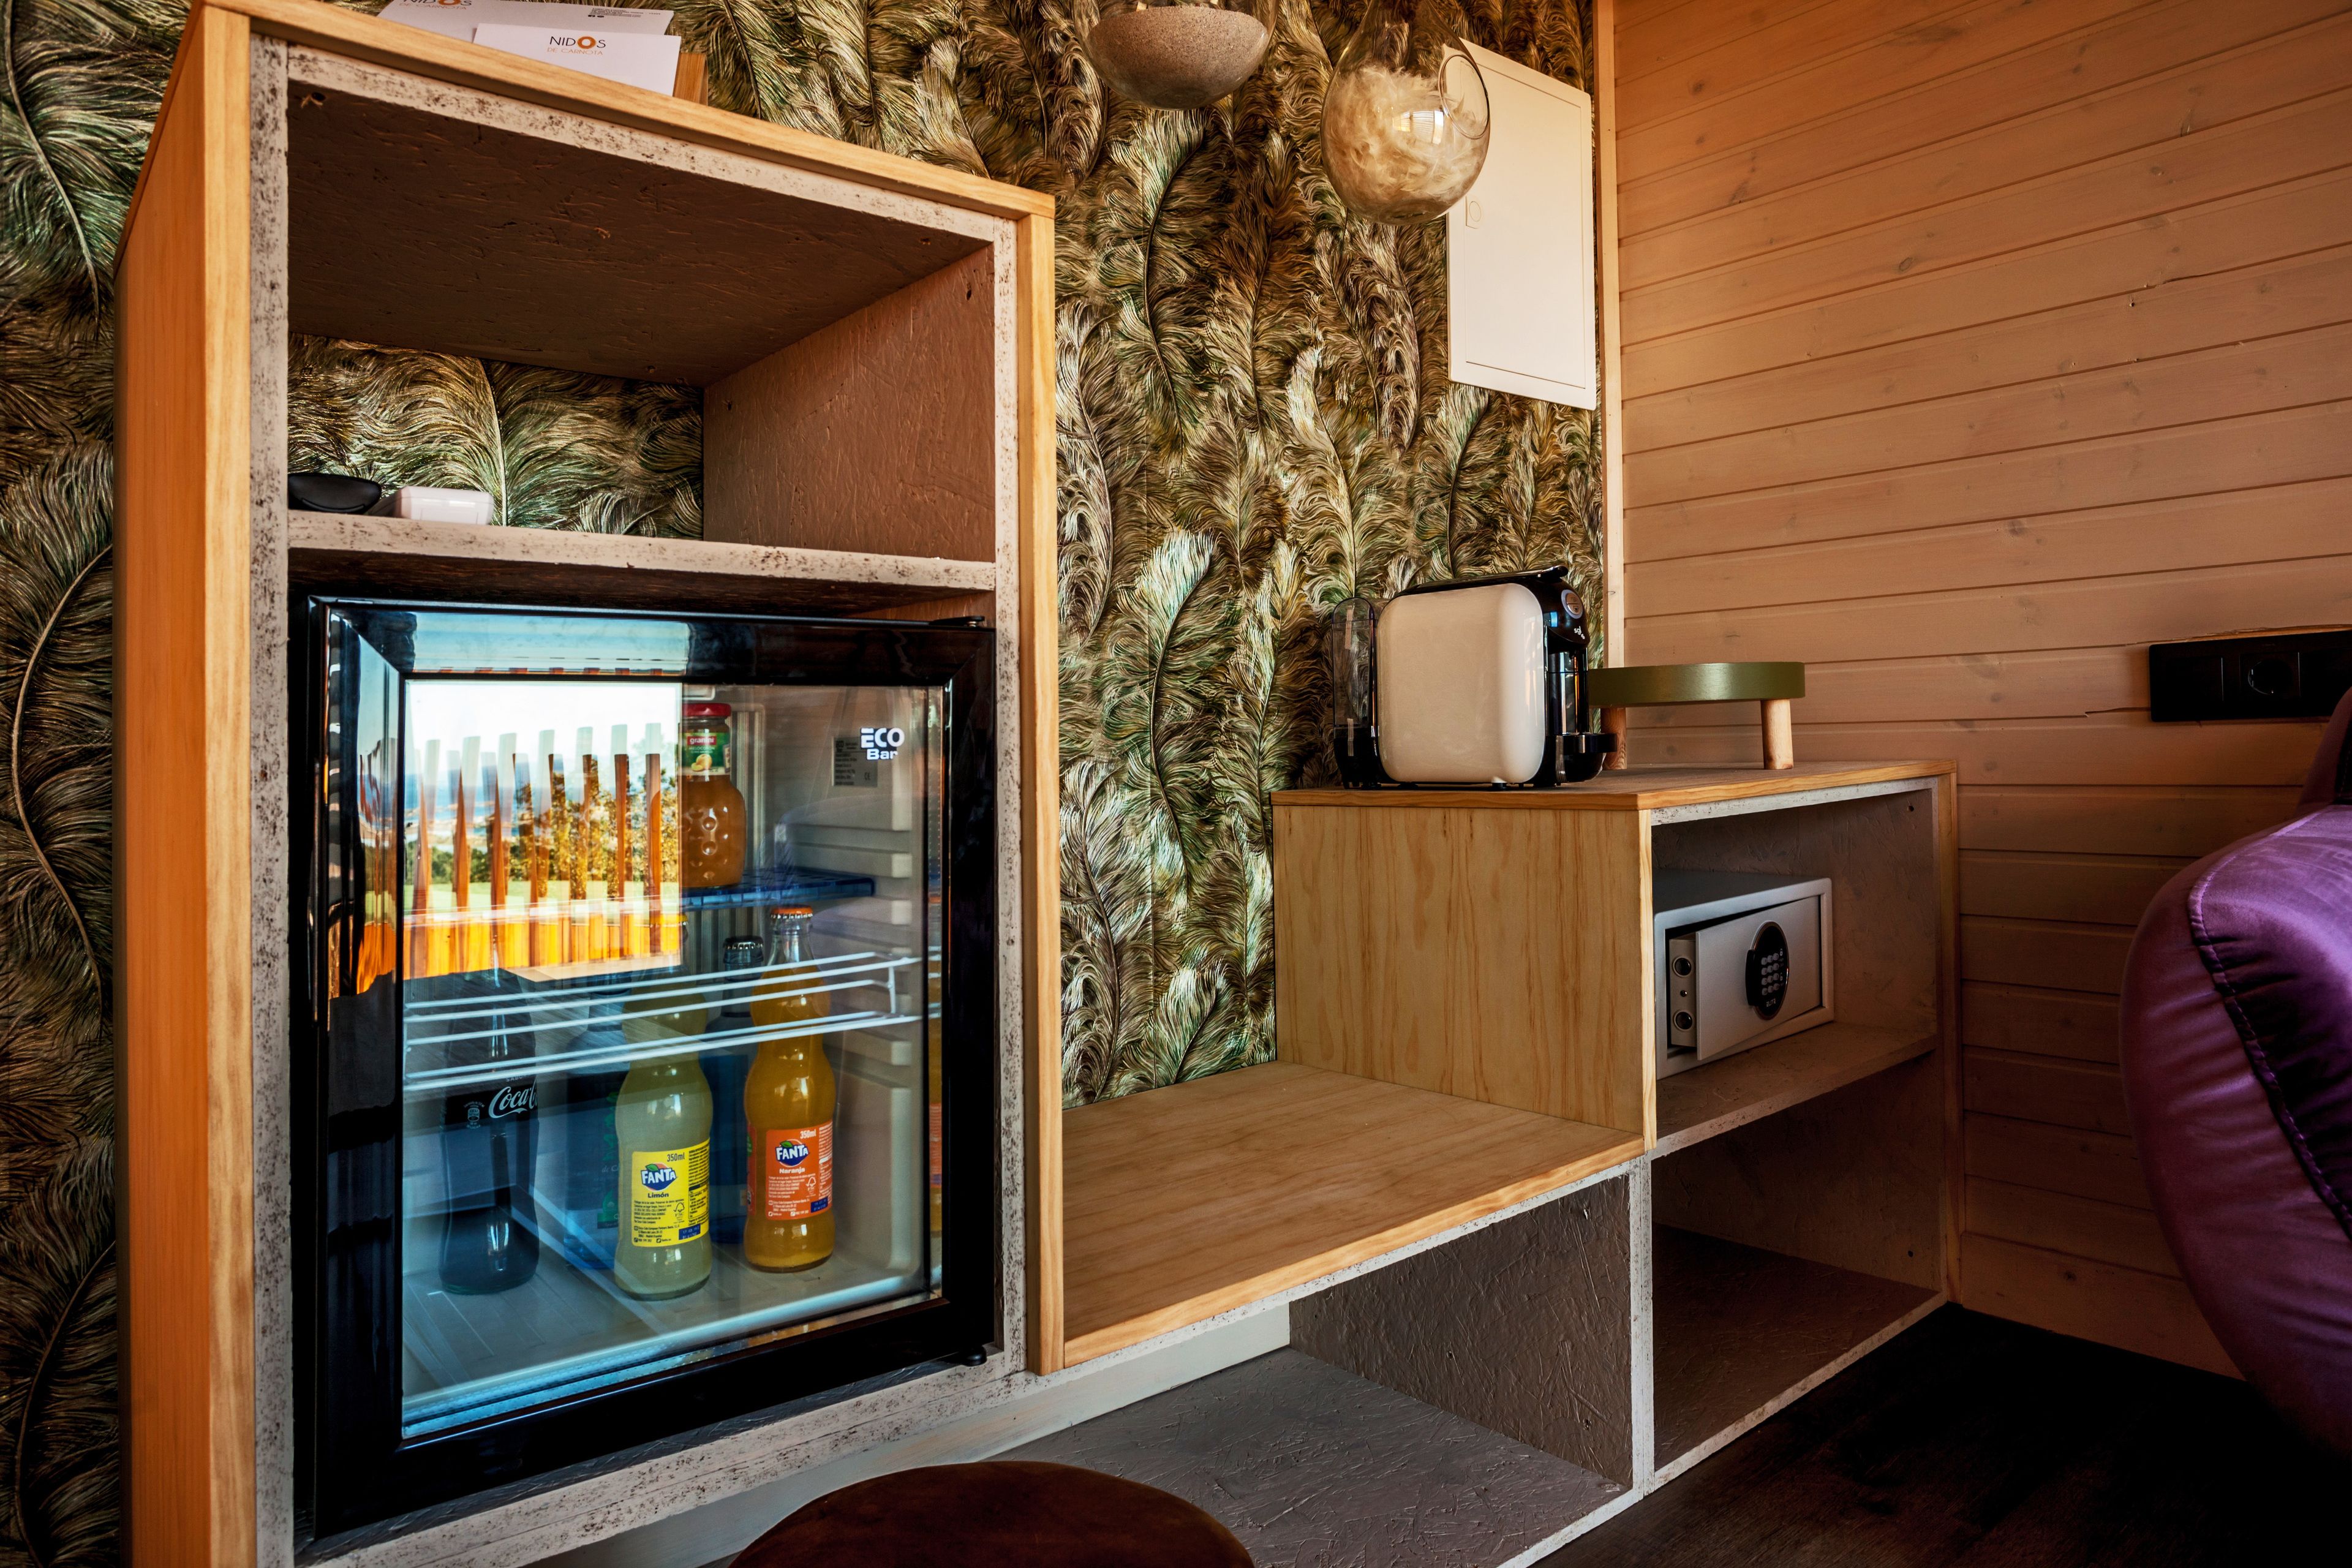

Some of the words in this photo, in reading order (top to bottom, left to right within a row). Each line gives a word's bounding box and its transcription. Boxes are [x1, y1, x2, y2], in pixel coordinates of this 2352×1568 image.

[549, 36, 606, 49] NIDOS
[861, 728, 905, 748] ECO
[867, 748, 898, 760] Bar
[800, 1129, 816, 1139] 350ml
[667, 1152, 685, 1162] 350ml
[775, 1144, 809, 1160] FANTA
[641, 1168, 676, 1184] FANTA
